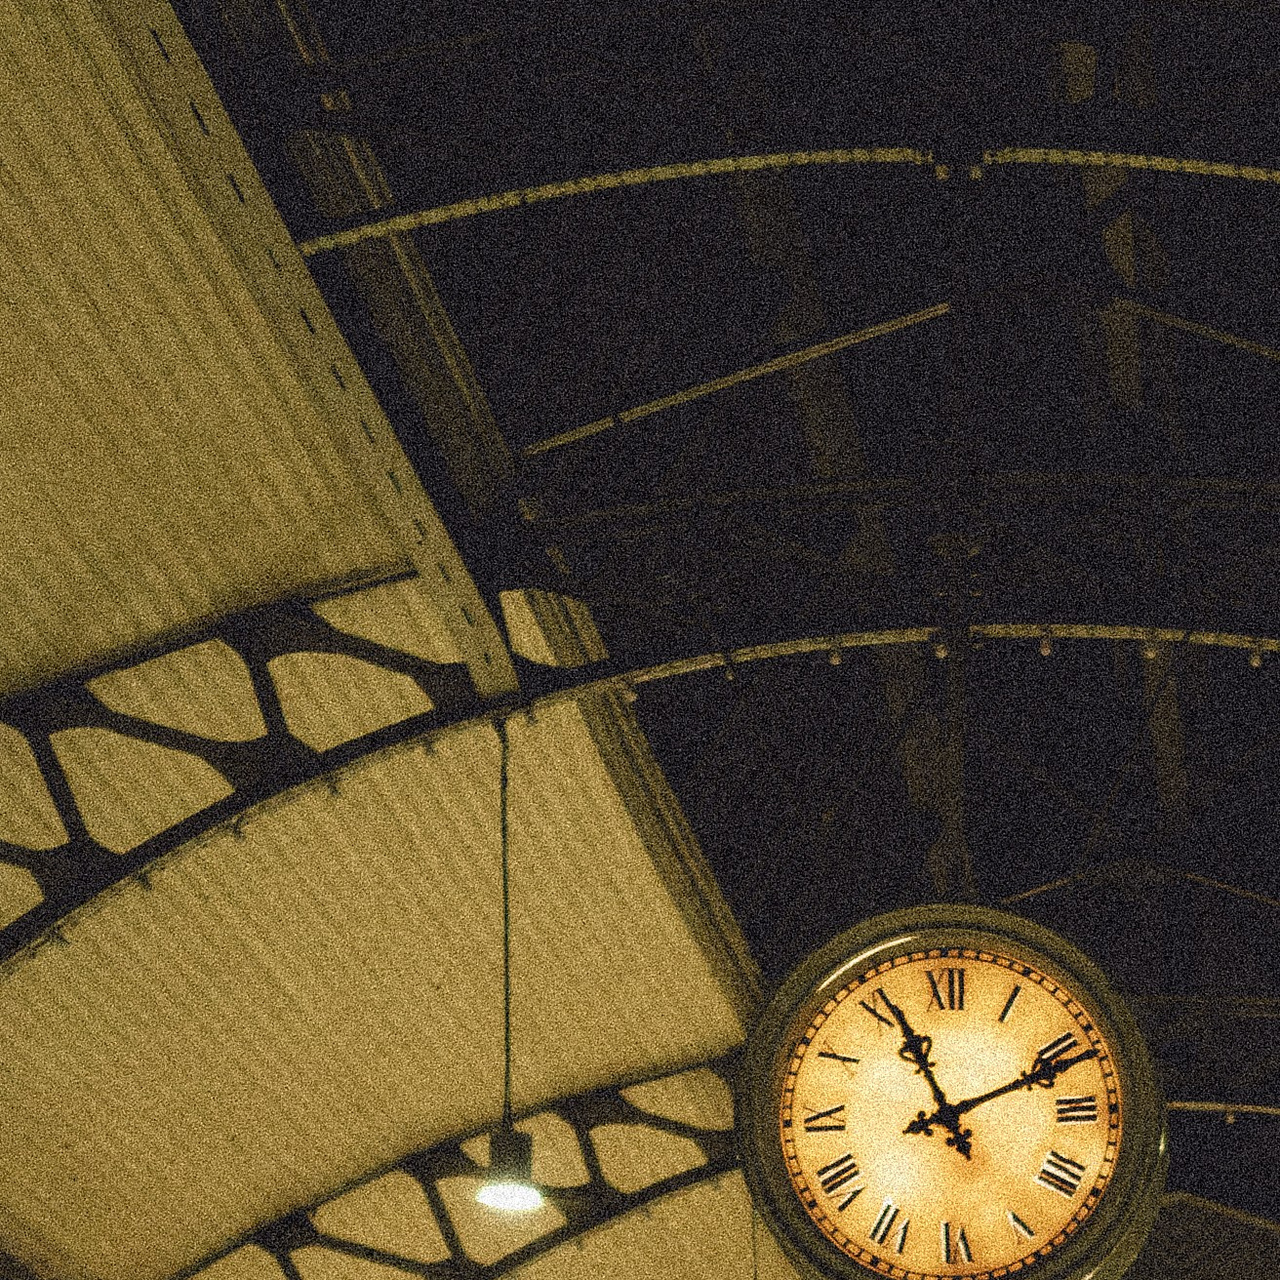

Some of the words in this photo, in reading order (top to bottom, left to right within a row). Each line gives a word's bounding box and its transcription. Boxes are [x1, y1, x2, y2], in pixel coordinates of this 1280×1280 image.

[925, 967, 966, 1012] XII
[998, 984, 1022, 1023] I
[818, 1040, 860, 1078] X
[802, 1104, 847, 1133] IX
[1055, 1095, 1097, 1123] III
[816, 1153, 866, 1213] VIII
[868, 1202, 910, 1255] VII
[939, 1221, 975, 1265] VI
[1008, 1210, 1036, 1245] V
